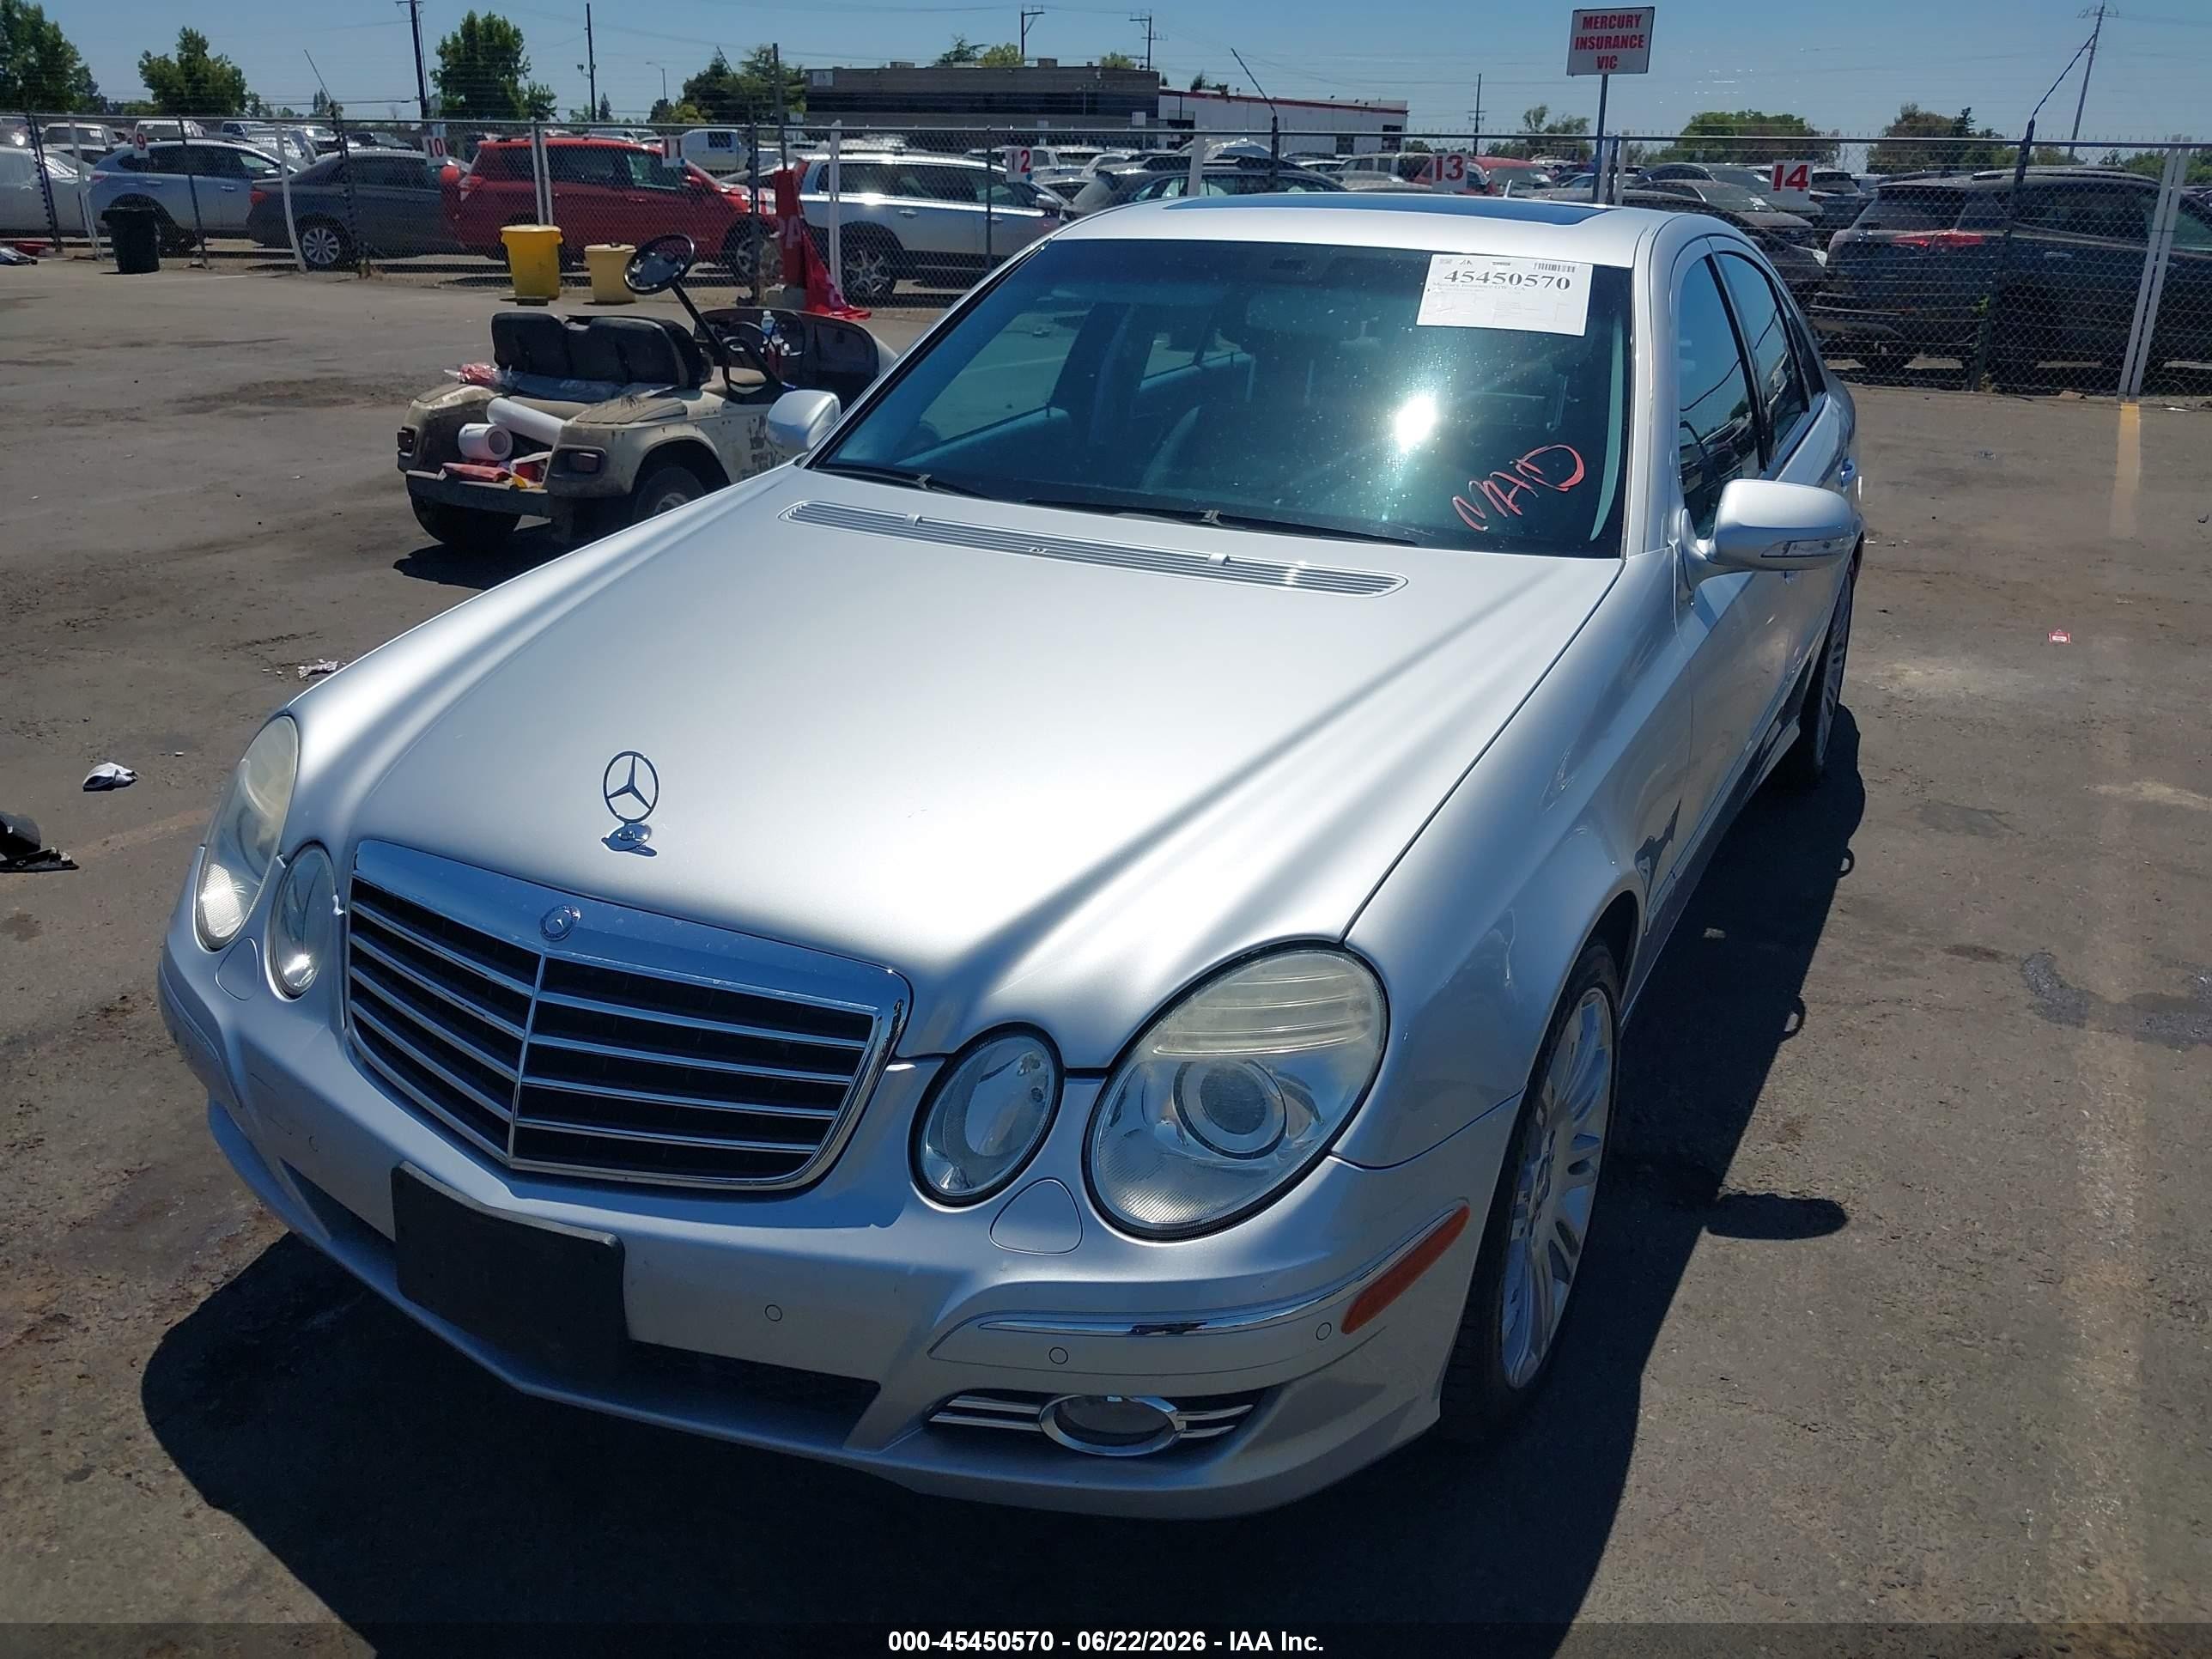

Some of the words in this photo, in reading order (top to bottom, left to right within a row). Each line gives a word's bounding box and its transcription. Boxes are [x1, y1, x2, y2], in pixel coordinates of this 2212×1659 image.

[1582, 14, 1642, 30] MERCURY
[1574, 34, 1644, 50] INSURANCE
[1597, 55, 1618, 70] VIC
[137, 133, 146, 151] 9
[428, 137, 444, 158] 10
[664, 137, 682, 159] 11
[1012, 149, 1031, 173] 12
[1436, 155, 1464, 181] 13
[1772, 164, 1808, 191] 14
[1443, 270, 1571, 290] 45450570
